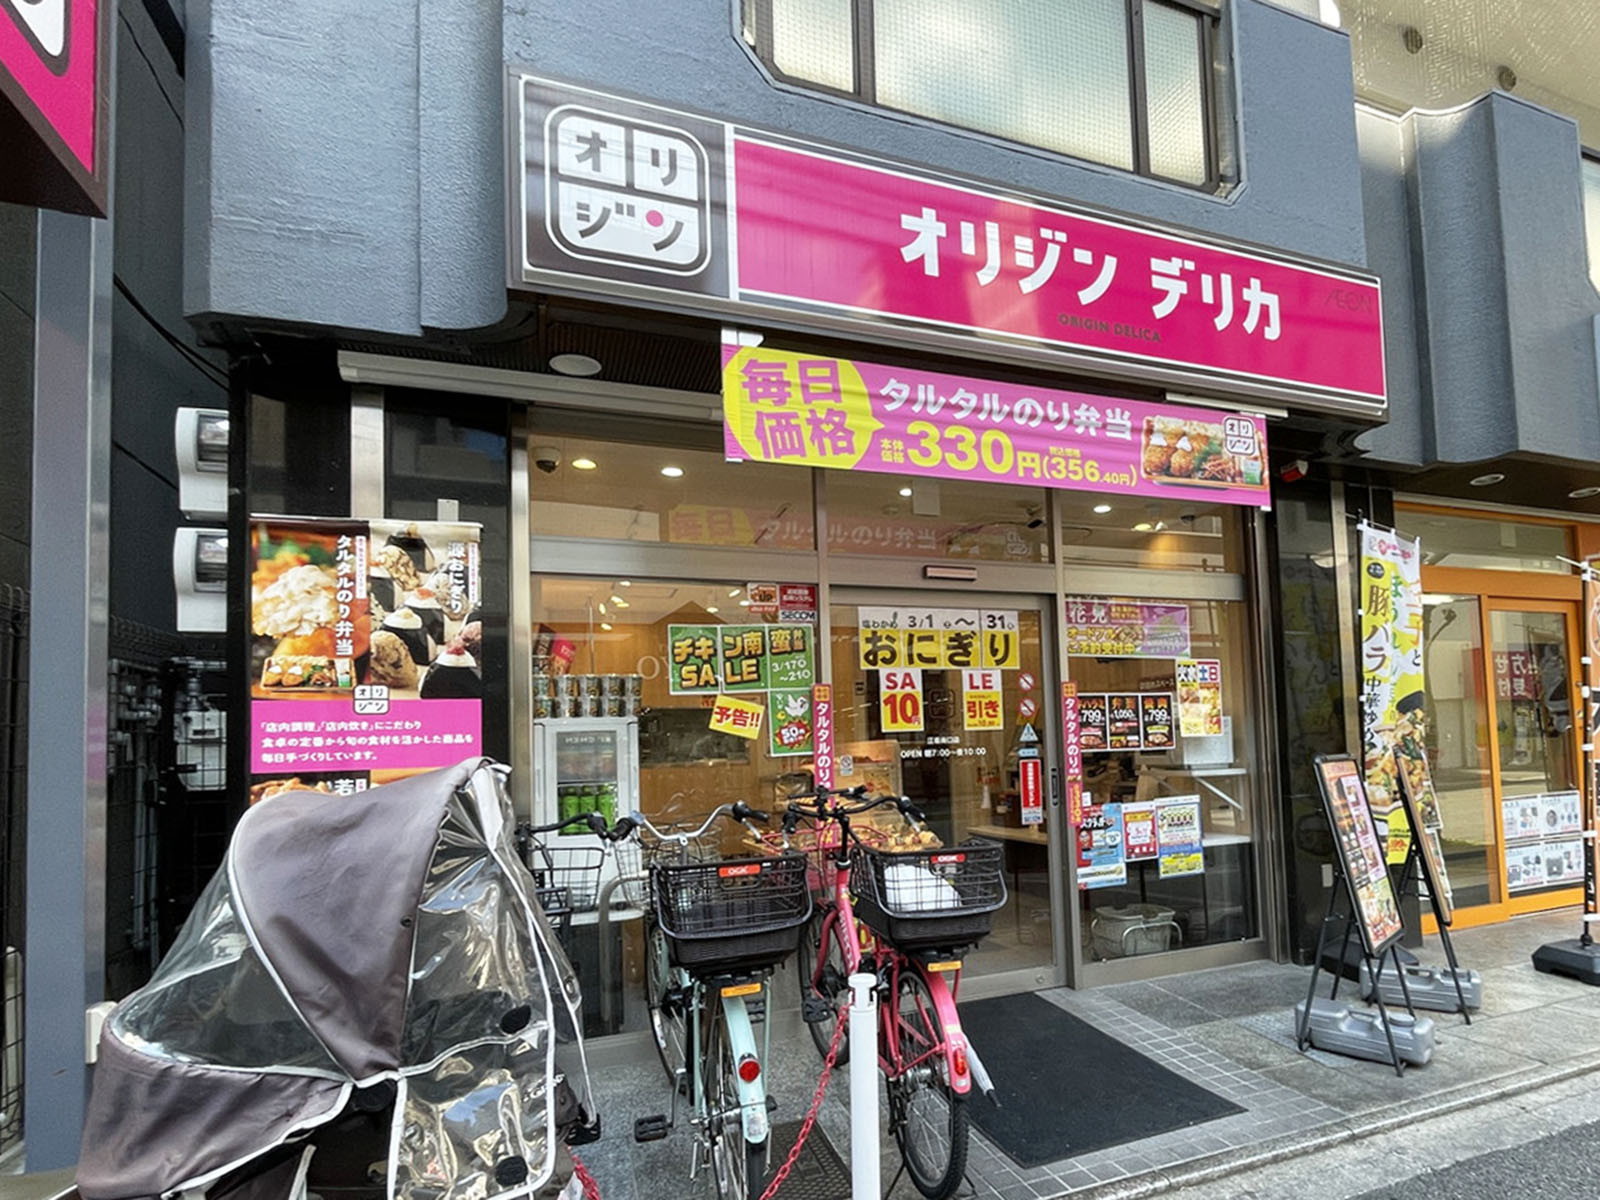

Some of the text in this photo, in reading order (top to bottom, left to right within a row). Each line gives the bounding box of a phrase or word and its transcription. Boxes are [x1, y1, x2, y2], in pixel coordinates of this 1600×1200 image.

[575, 130, 678, 186] オリ
[576, 201, 684, 252] ジン
[899, 206, 1281, 341] オリジン デリカ
[1058, 313, 1161, 343] ORIGIN DELICA
[740, 358, 842, 406] 毎日
[879, 378, 1132, 440] タルタルのり弁当
[754, 408, 856, 459] 価格
[907, 420, 1041, 479] 330円
[335, 534, 355, 657] タルタルのり弁当
[863, 630, 1010, 667] おにぎり
[681, 659, 759, 688] SALE
[260, 720, 421, 733] 「店内調理」「店内炊き」にこだわり
[714, 705, 760, 727] 予告!!
[967, 700, 999, 719] 引き
[261, 734, 474, 748] 食卓の定番から旬の食材を活かした商品を
[261, 751, 378, 764] 毎日手づくりしています。
[900, 749, 922, 758] OPEN
